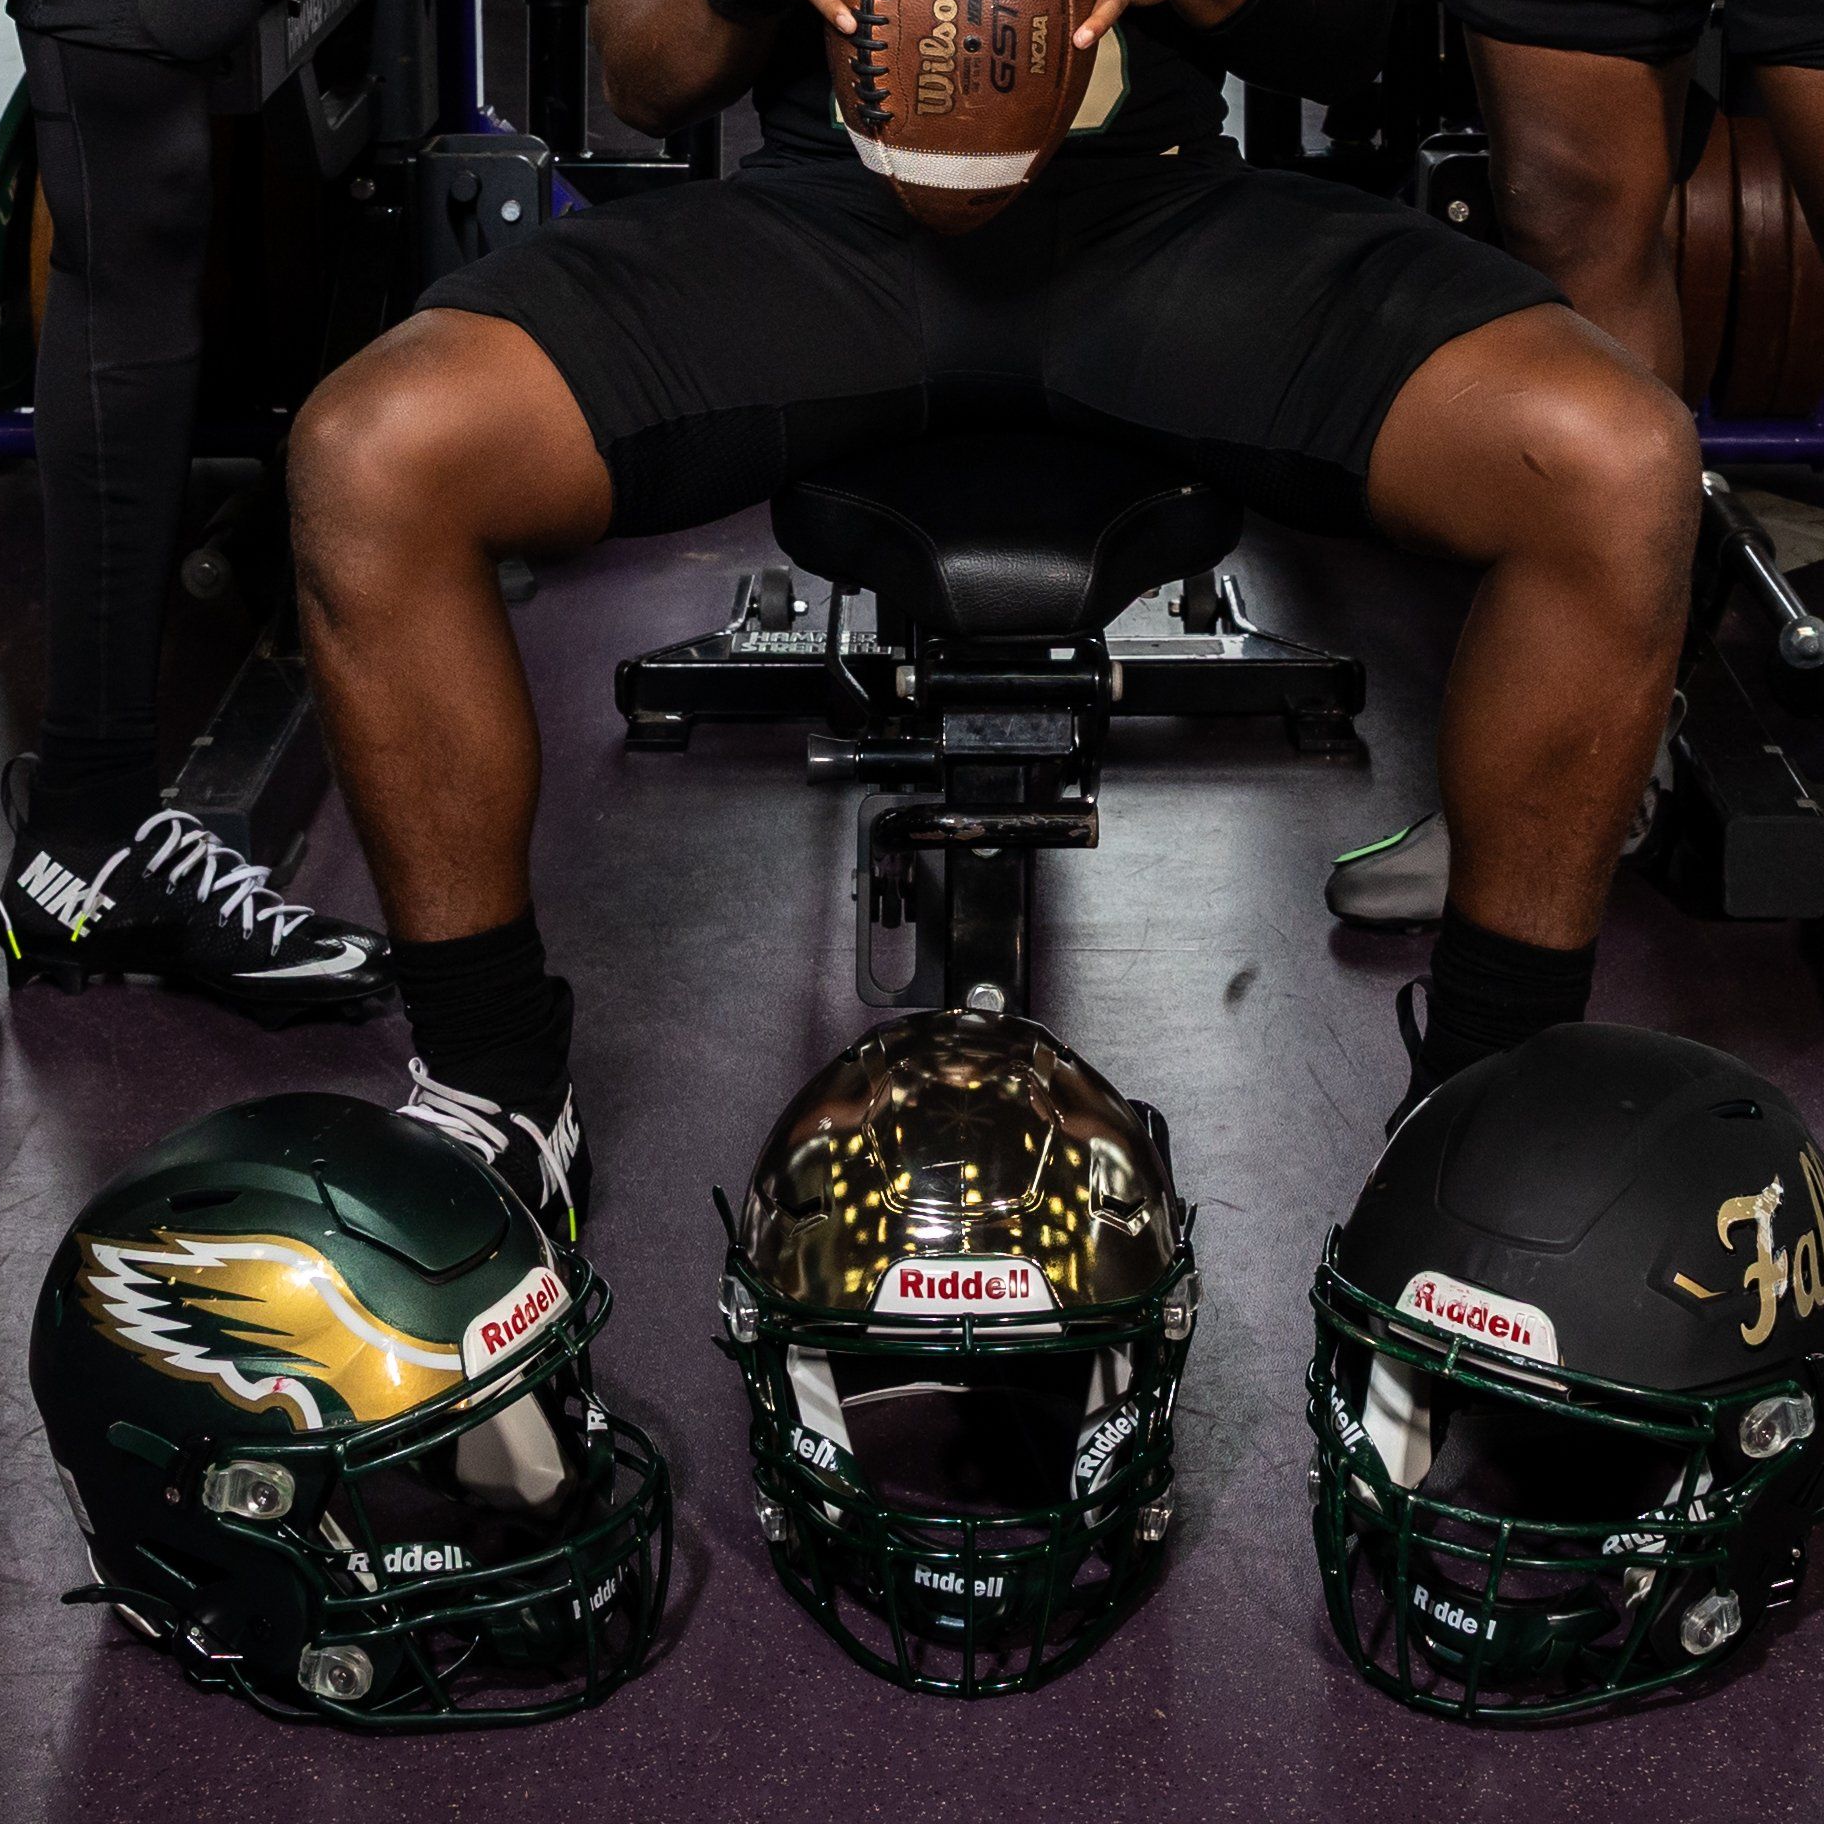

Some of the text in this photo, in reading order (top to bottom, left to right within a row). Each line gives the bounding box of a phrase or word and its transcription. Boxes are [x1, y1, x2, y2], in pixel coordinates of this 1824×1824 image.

[1030, 14, 1049, 75] NCAA
[16, 850, 117, 938] NIKE
[480, 1273, 561, 1356] Riddell
[899, 1267, 1029, 1301] Riddell
[1414, 1281, 1533, 1347] Riddell
[346, 1544, 466, 1574] Rddell
